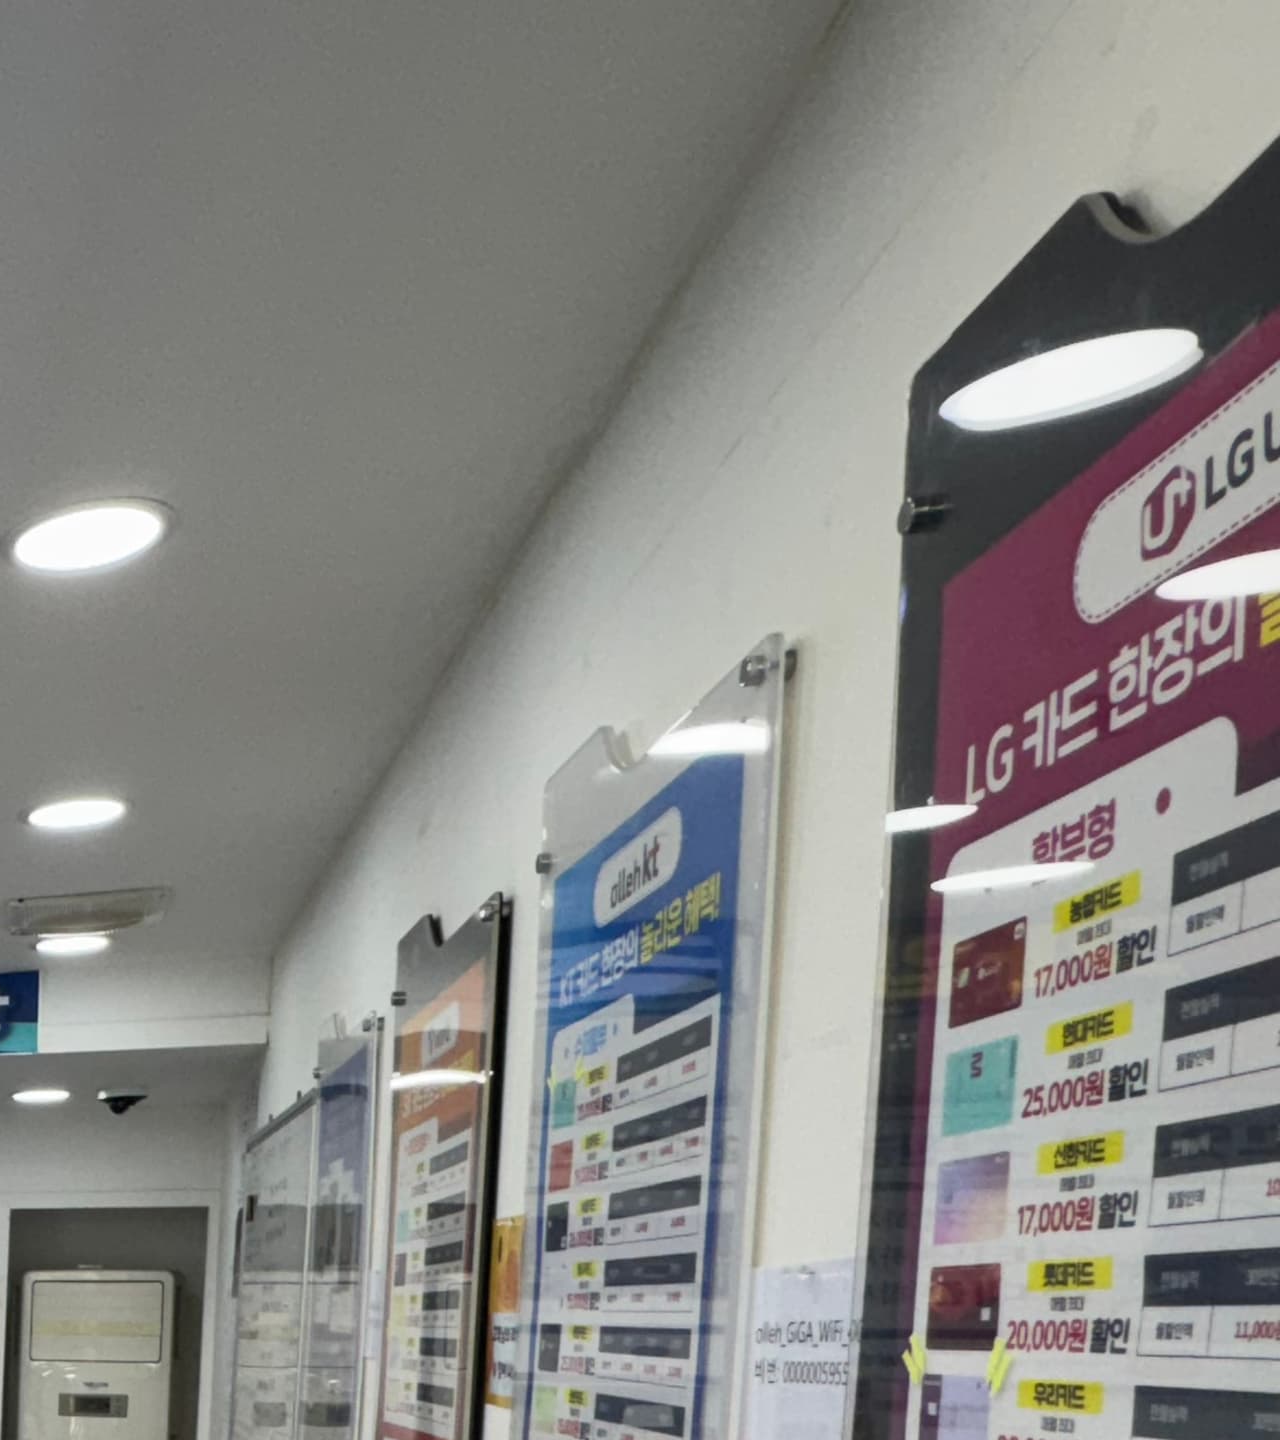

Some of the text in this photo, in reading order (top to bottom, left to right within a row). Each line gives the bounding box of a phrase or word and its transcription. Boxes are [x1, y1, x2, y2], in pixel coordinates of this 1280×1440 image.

[966, 724, 1014, 804] LG
[1023, 669, 1098, 767] 카드
[1109, 596, 1246, 732] 한장의
[1034, 926, 1157, 998] 17,000원 할인
[1022, 1059, 1149, 1118] 25,000원 할인
[1018, 1191, 1138, 1235] 17,000원 할인
[1007, 1317, 1130, 1354] 20,000원 할인
[1033, 1382, 1085, 1409] 우리카드
